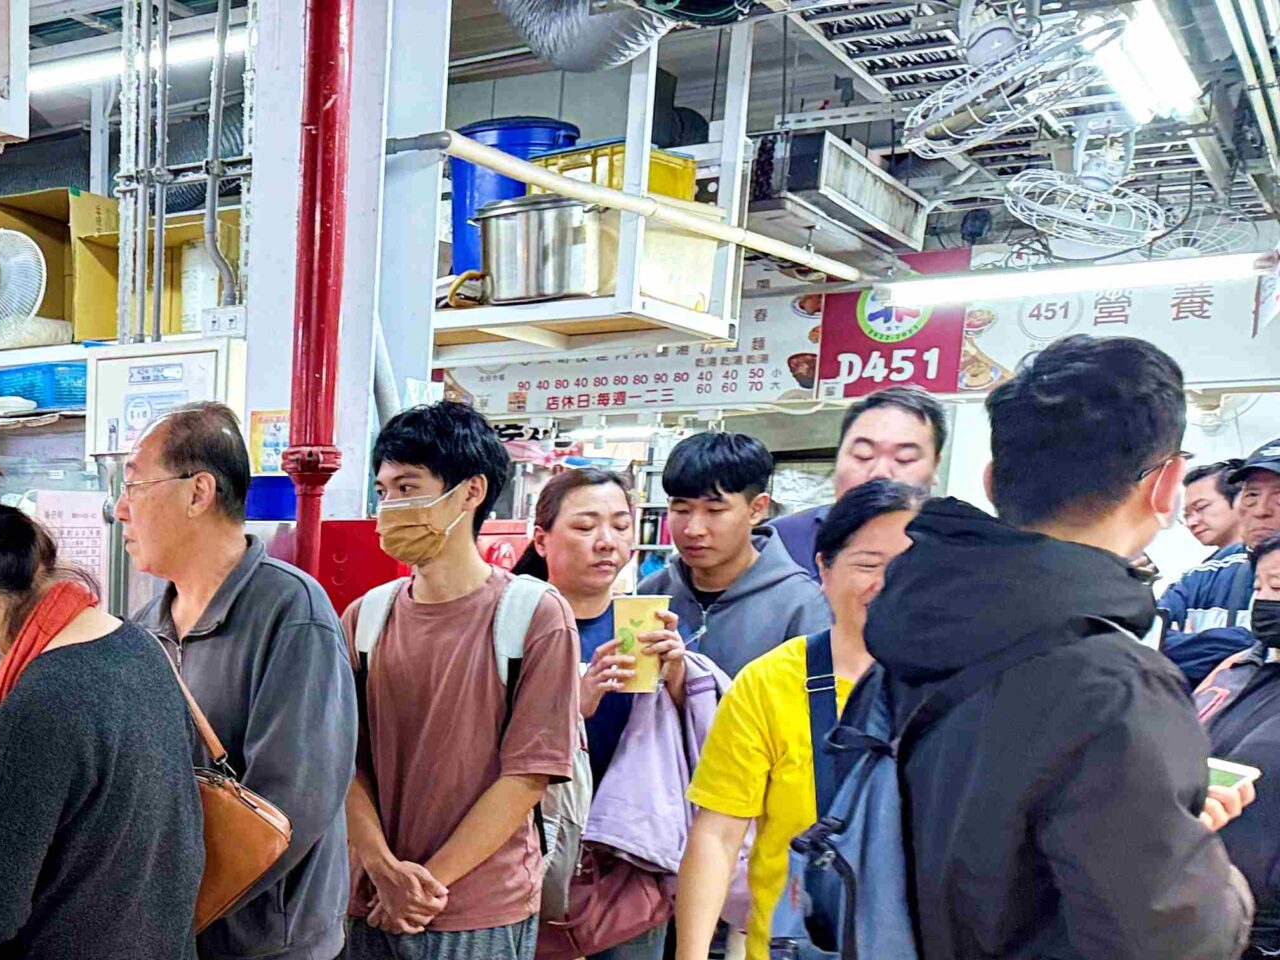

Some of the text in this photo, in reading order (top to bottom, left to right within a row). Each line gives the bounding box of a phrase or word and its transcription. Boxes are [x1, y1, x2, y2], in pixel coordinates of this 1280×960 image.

[1029, 300, 1071, 322] 451
[837, 347, 941, 385] D451
[518, 381, 531, 391] 90
[536, 380, 550, 390] 40
[555, 379, 569, 389] 80
[574, 377, 588, 388] 40
[593, 376, 608, 387] 80
[613, 375, 628, 385] 80
[632, 374, 648, 385] 80
[654, 373, 668, 383] 90
[673, 372, 689, 382] 80
[697, 371, 713, 381] 40
[722, 369, 738, 380] 40
[749, 368, 764, 379] 50
[696, 383, 712, 394] 60
[722, 382, 737, 393] 60
[748, 381, 763, 391] 70
